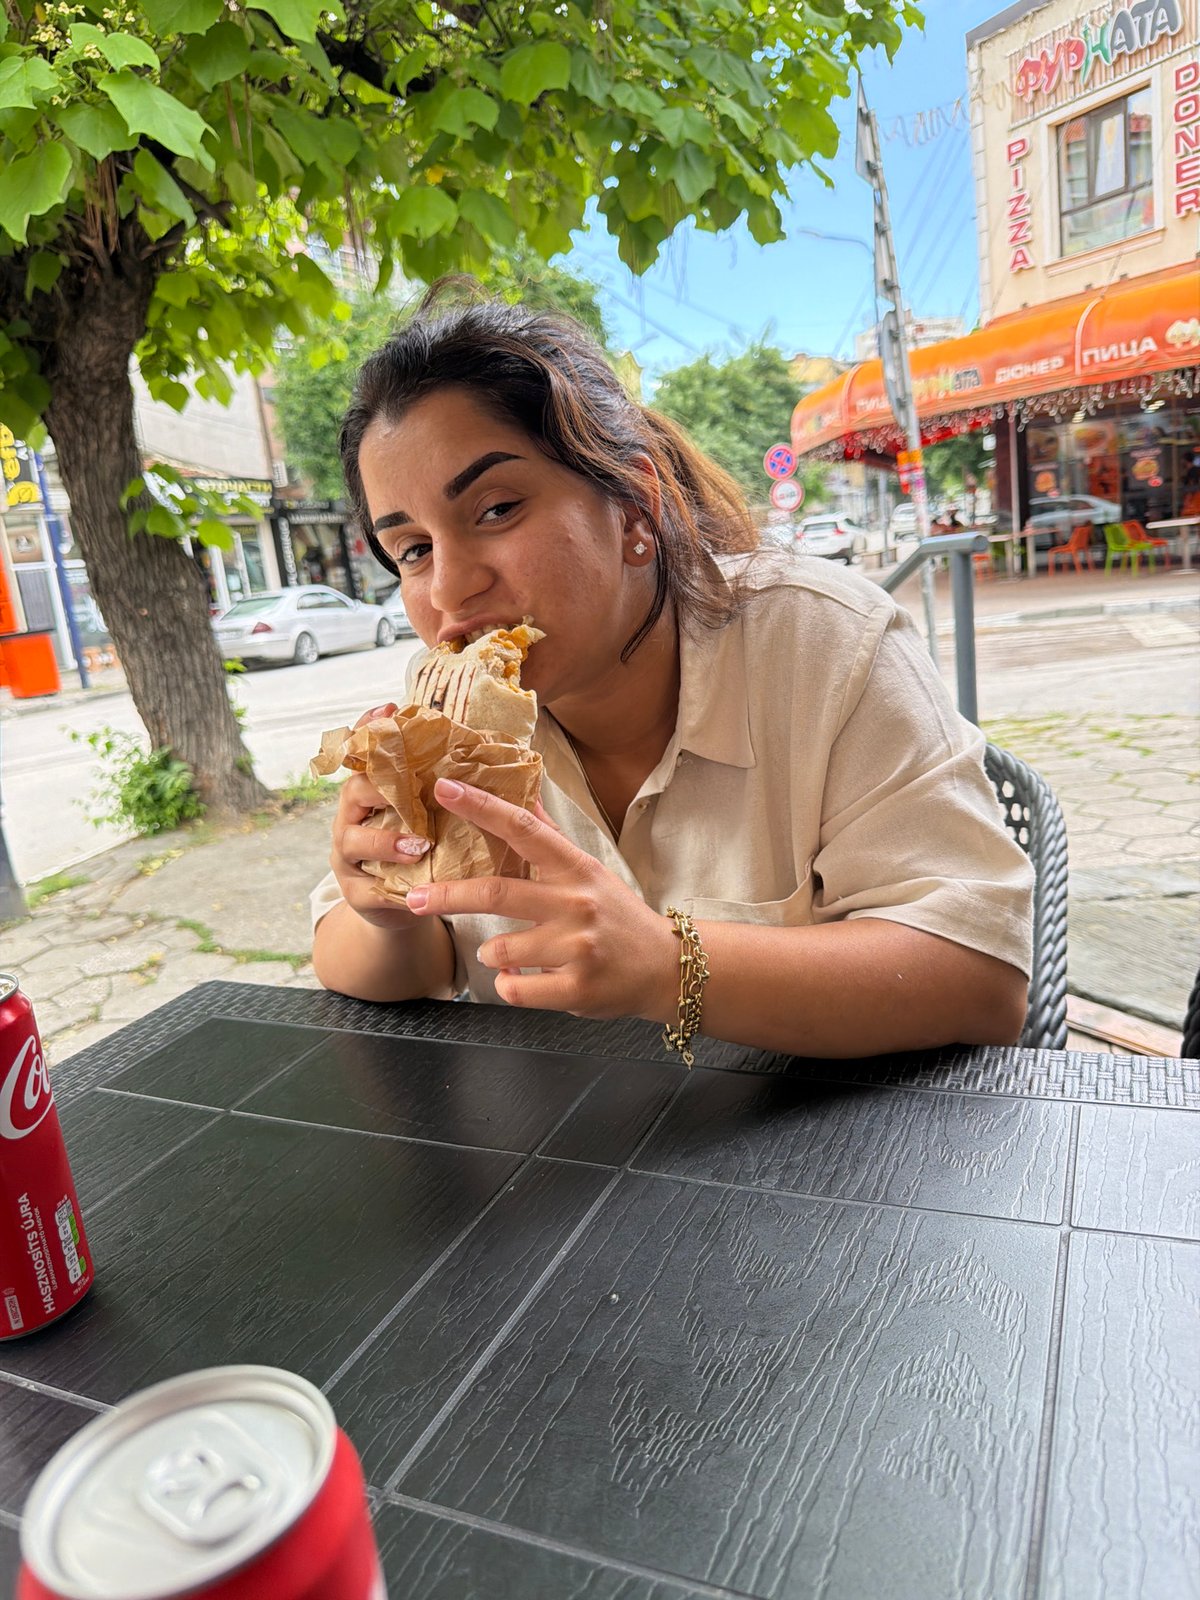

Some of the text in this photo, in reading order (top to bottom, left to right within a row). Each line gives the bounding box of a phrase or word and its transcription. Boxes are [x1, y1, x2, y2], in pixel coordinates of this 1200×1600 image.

[1007, 138, 1031, 272] PIZZA
[995, 355, 1065, 384] ДЮНЕР
[1082, 336, 1158, 365] ПИЦА
[18, 1192, 56, 1314] HASZNOSÍTS ÚJRA
